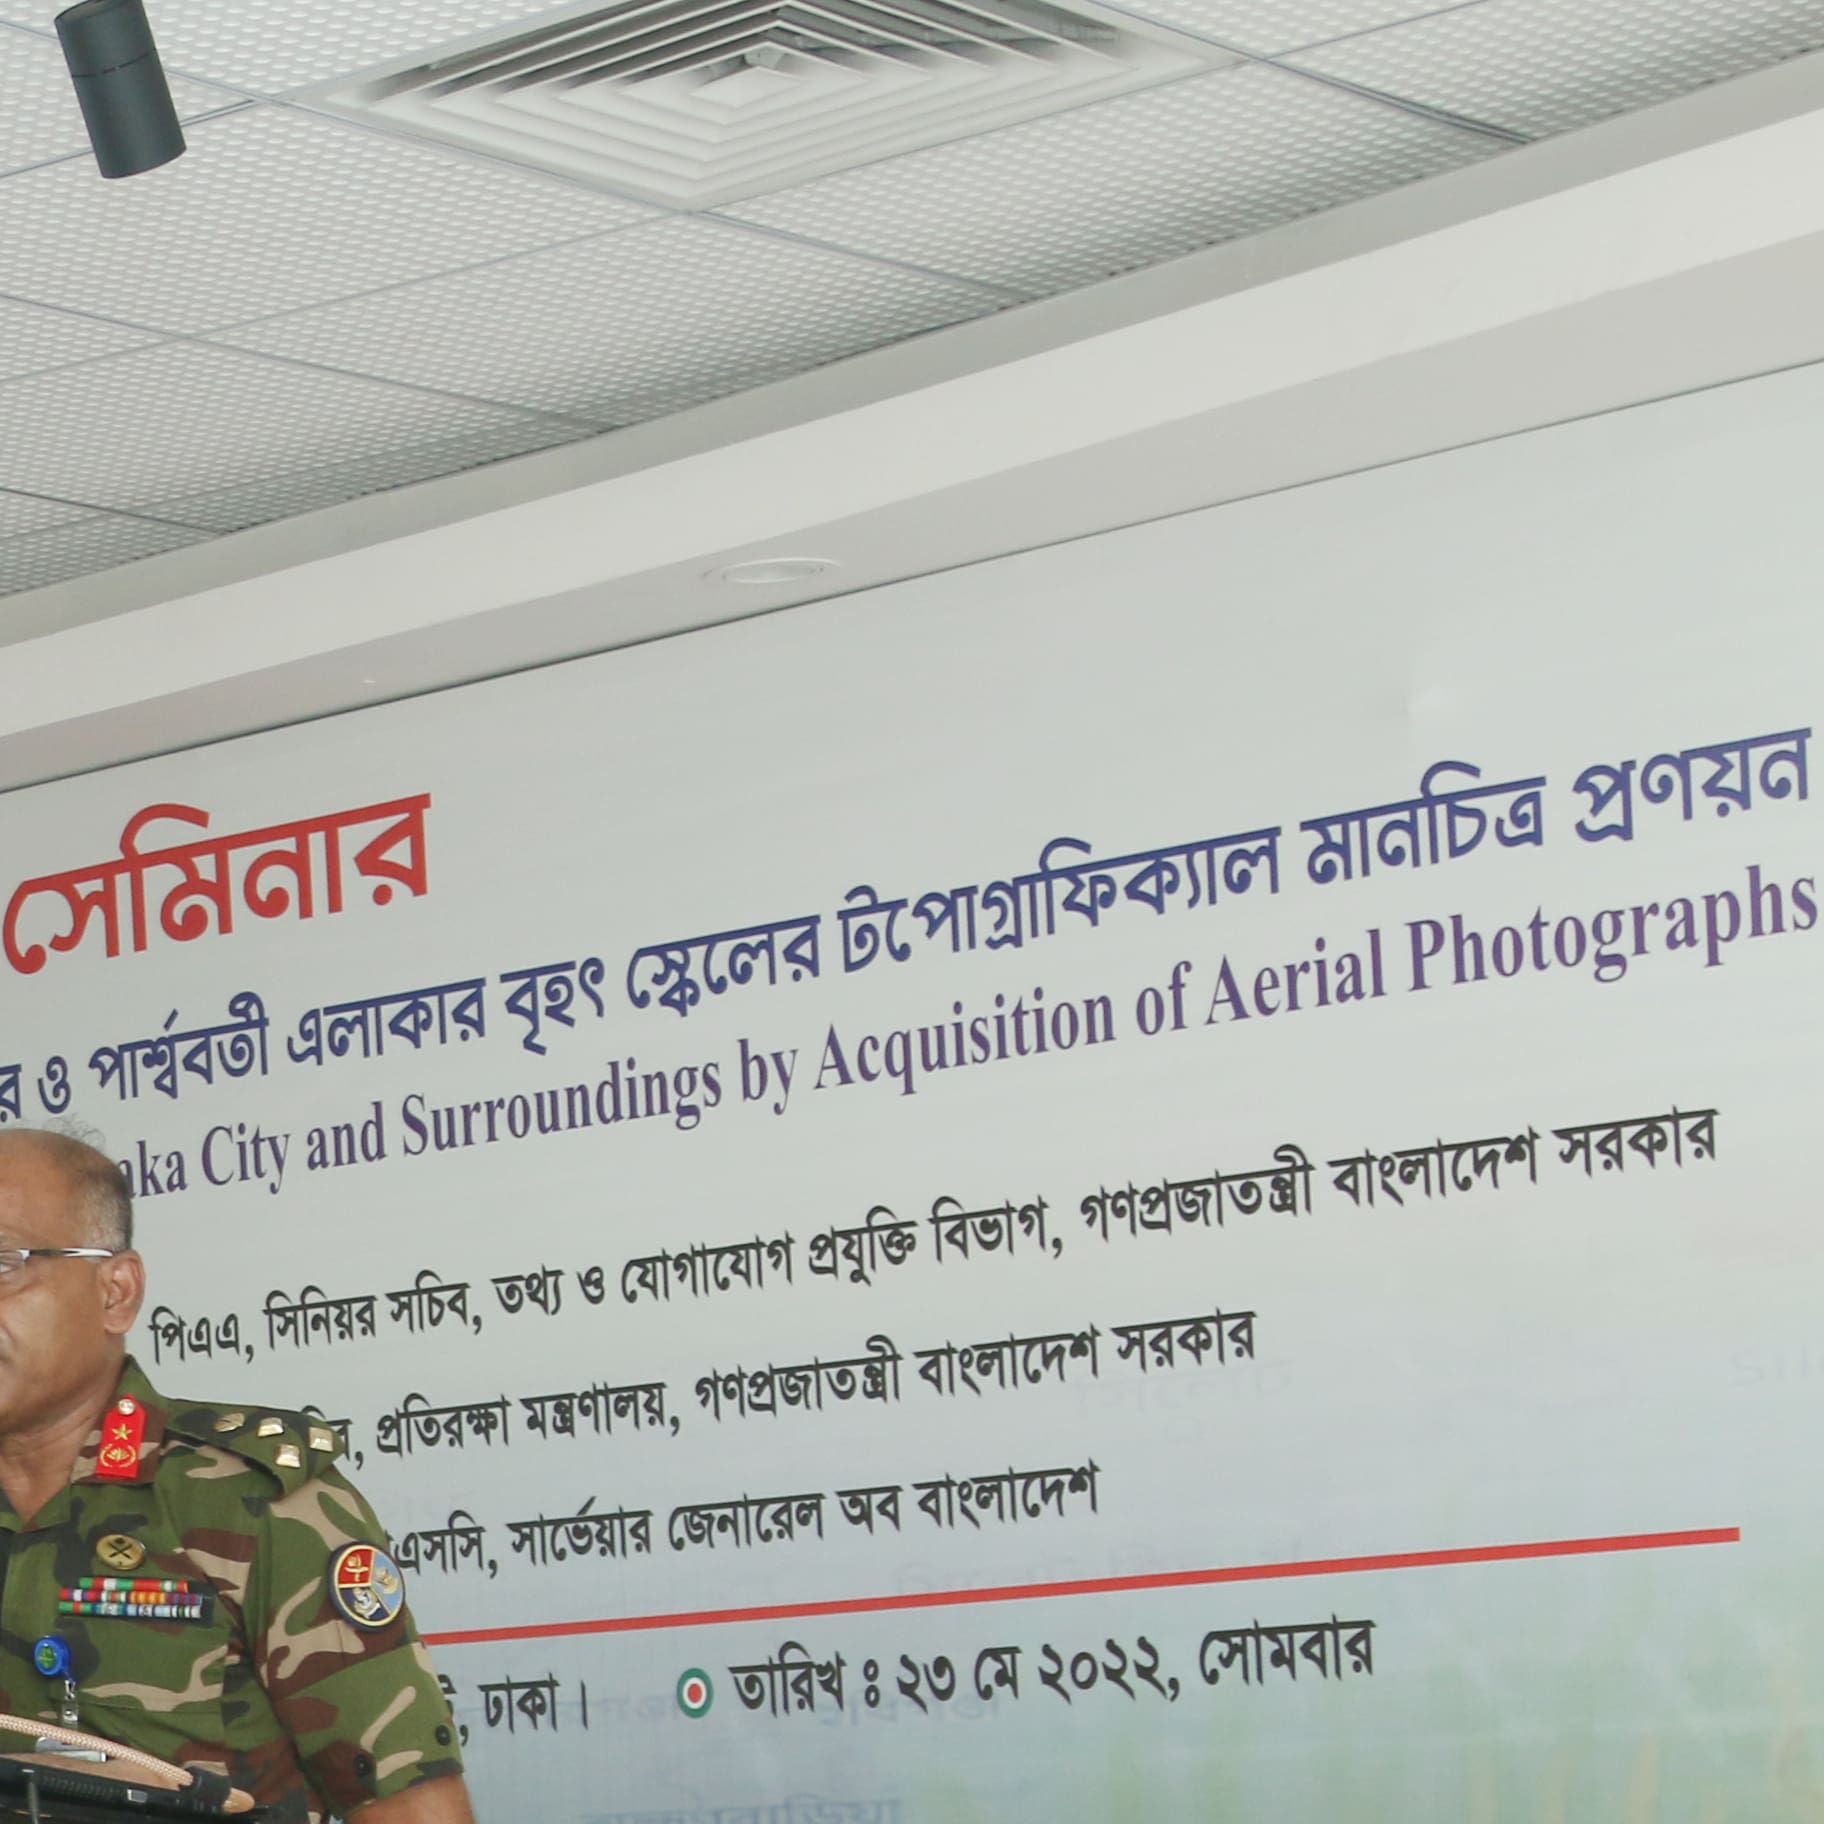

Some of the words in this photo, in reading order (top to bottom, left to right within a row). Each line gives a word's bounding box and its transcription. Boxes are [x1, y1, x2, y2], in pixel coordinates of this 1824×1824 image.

[3, 794, 431, 973] সেমিনার
[37, 1056, 71, 1114] ও
[287, 977, 486, 1066] এলাকার
[499, 957, 605, 1056] বৃহৎ
[626, 914, 821, 1018] স্কেলের
[1299, 760, 1546, 884] মানচিত্র
[1572, 727, 1812, 842] প্রণয়ন
[201, 1122, 290, 1194] City
[307, 1101, 387, 1171] and
[402, 1057, 721, 1156] Surroundings
[737, 1038, 798, 1115] by
[814, 987, 1116, 1096] Acquisition
[1136, 960, 1192, 1035] of
[1204, 928, 1387, 1025] Aerial
[1404, 865, 1817, 992] Photographs
[262, 1285, 378, 1350] সিনিয়র
[384, 1269, 482, 1335] সচিব,
[490, 1264, 565, 1316] তথ্য
[576, 1266, 605, 1305] ও
[621, 1230, 796, 1304] যোগাযোগ
[926, 1194, 1063, 1264] বিভাগ,
[1080, 1143, 1316, 1242] গণপ্রজাতন্ত্রী
[1326, 1125, 1541, 1208] বাংলাদেশ
[1550, 1105, 1720, 1178] সরকার
[376, 1393, 512, 1458] প্রতিরক্ষা
[695, 1334, 904, 1422] গণপ্রজাতন্ত্রী
[912, 1323, 1102, 1396] বাংলাদেশ
[1110, 1307, 1257, 1373] সরকার
[668, 1493, 826, 1551] জেনারেল
[834, 1485, 904, 1535] অব
[911, 1458, 1101, 1530] বাংলাদেশ
[477, 1672, 560, 1734] ঢাকা
[728, 1641, 847, 1718] তারিখ
[896, 1654, 956, 1714] ২৩
[974, 1646, 1022, 1701] মে
[1038, 1636, 1180, 1704] ২০২২,
[1199, 1613, 1376, 1686] সোমবার
